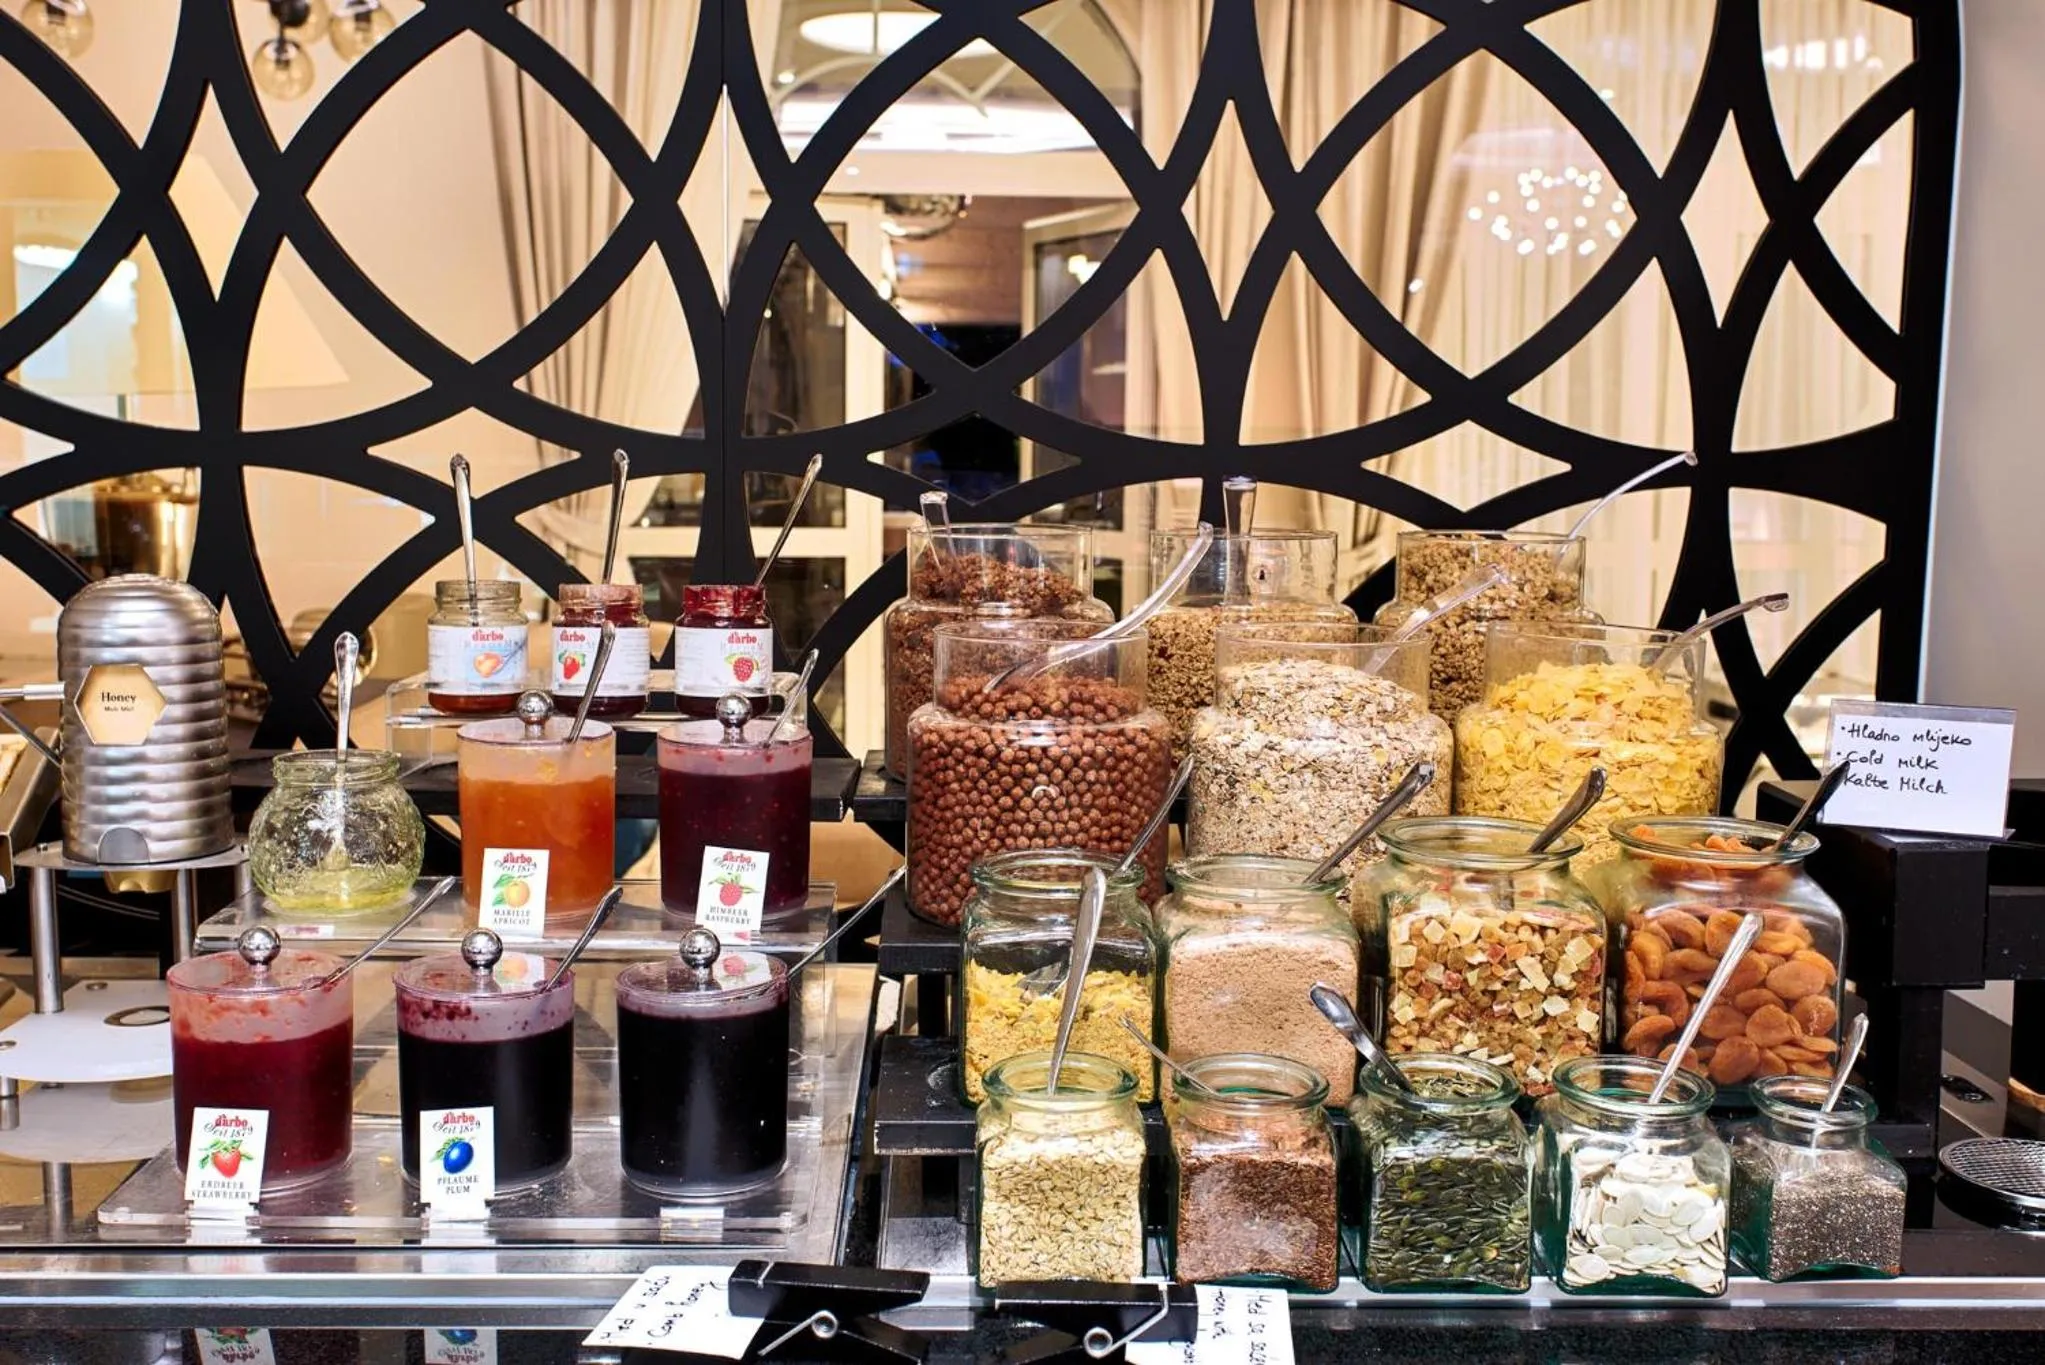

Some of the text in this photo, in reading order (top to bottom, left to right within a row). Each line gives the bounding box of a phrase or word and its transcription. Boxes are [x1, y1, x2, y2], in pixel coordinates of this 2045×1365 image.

[101, 692, 136, 703] Honey
[1848, 723, 1900, 741] Hladno
[1844, 749, 1884, 765] Cold
[1844, 773, 1948, 794] Kalte Milch
[493, 917, 530, 925] APRICOT
[705, 914, 751, 925] RASPBERRY
[200, 1180, 244, 1189] ERDBEER
[437, 1175, 479, 1185] PFLAUME
[446, 1185, 470, 1194] PLUM
